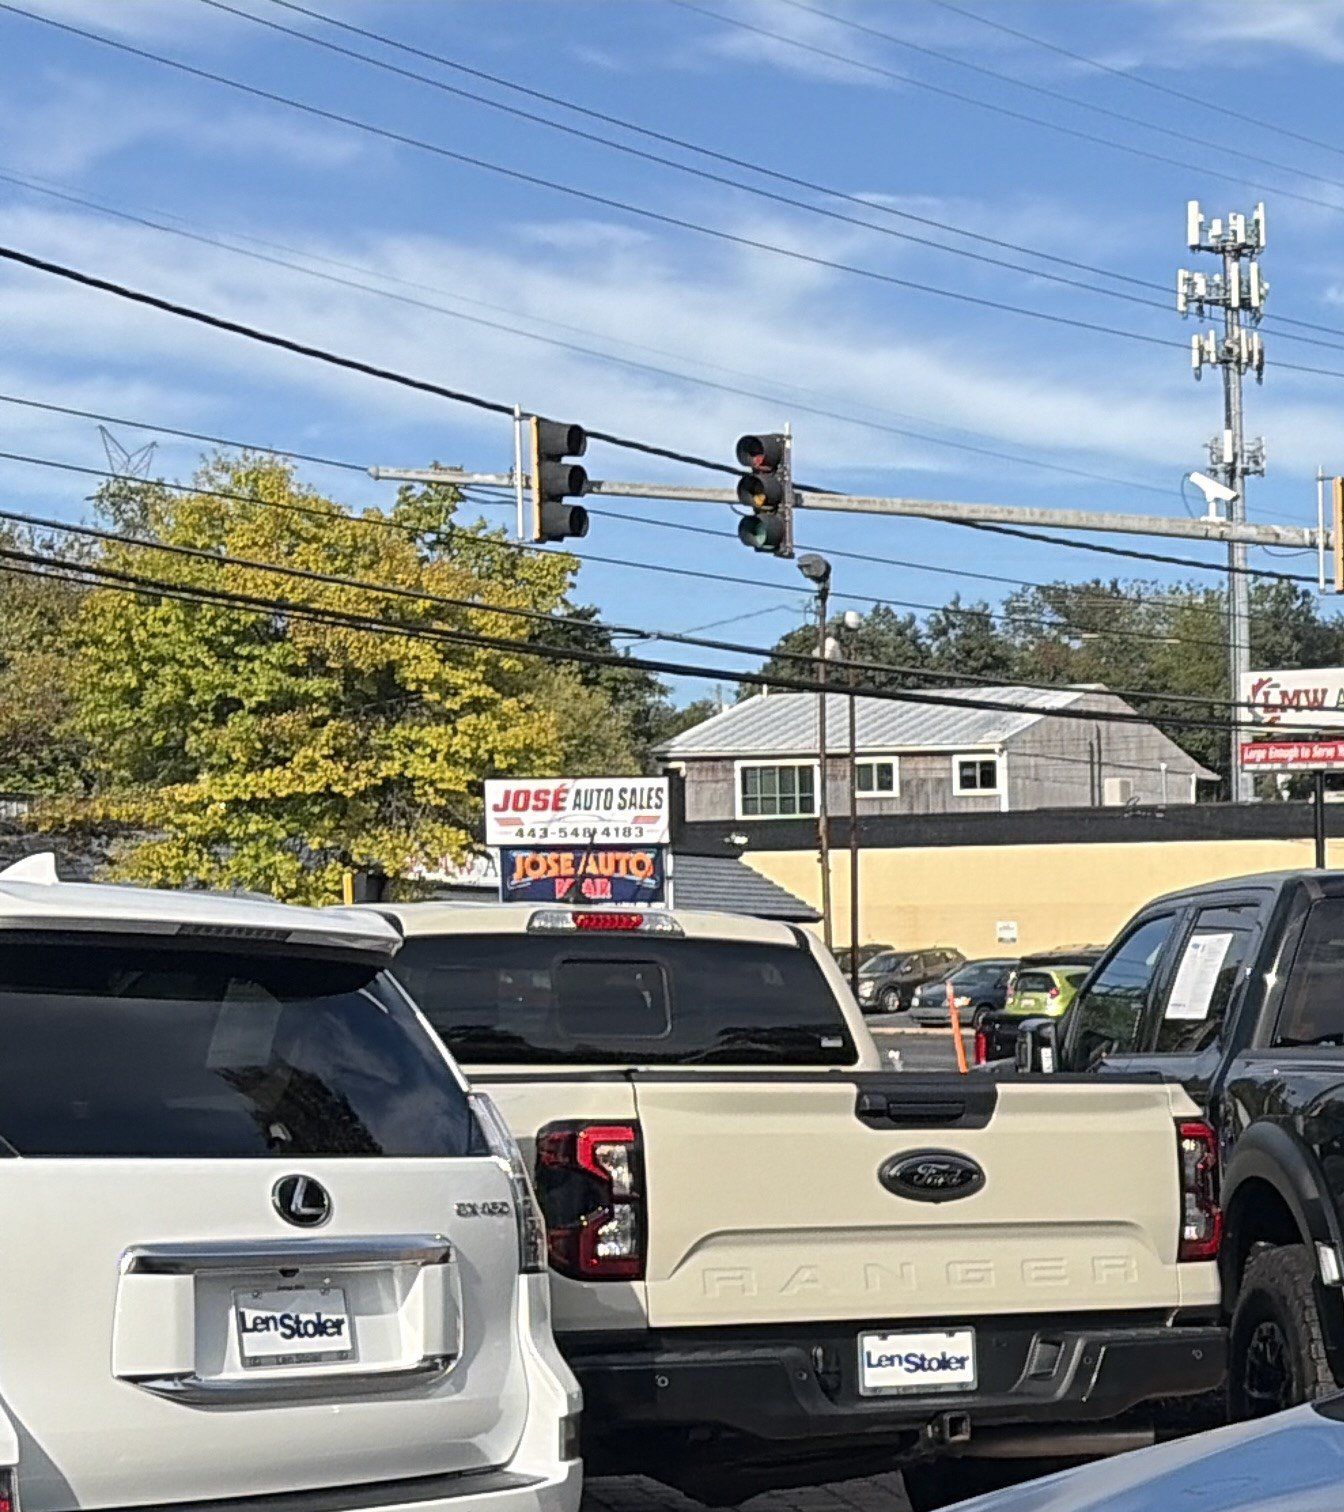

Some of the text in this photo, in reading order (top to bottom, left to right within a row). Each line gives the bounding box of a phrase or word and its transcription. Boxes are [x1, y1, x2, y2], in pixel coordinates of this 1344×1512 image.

[492, 784, 665, 813] JOSÉ AUTO SALES
[702, 1255, 1139, 1298] RANGER
